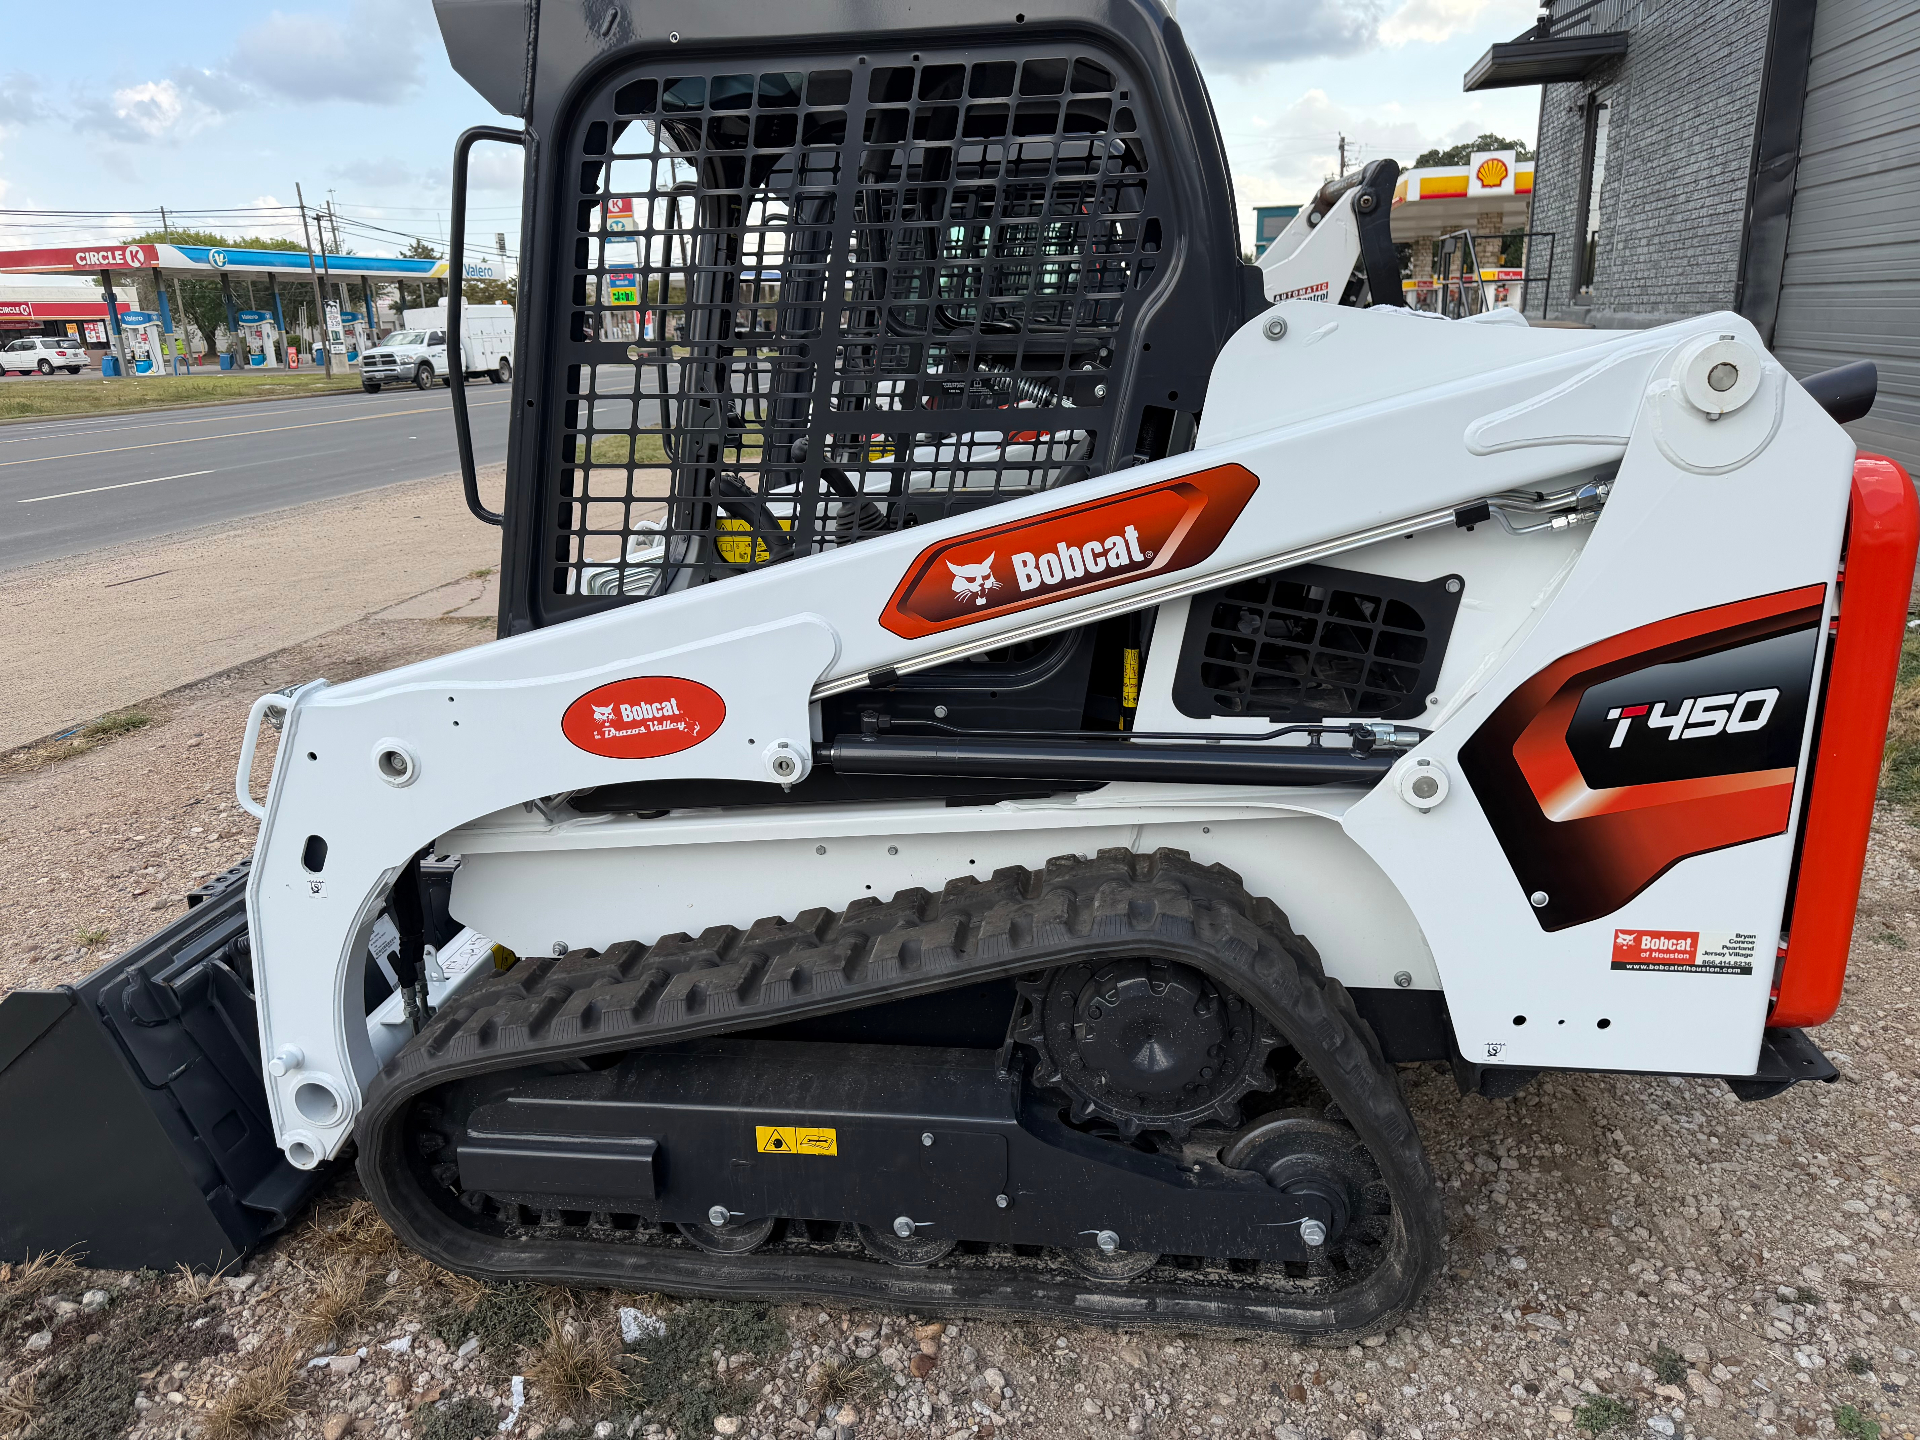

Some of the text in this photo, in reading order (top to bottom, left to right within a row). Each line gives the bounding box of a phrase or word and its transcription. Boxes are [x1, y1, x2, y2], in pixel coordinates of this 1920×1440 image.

[75, 248, 143, 266] CIRCLE K
[464, 263, 494, 278] Valero
[1275, 283, 1328, 303] AUTOMATIC
[0, 305, 29, 315] CIRCLE K
[1011, 524, 1145, 592] Bobcat
[619, 697, 680, 722] Bobcat
[1606, 687, 1781, 749] T450
[602, 719, 687, 739] Brazos Valley
[1640, 935, 1692, 951] Bobcat
[1701, 950, 1727, 958] Jersey
[1625, 963, 1741, 973] www.bobcatofhouston.com
